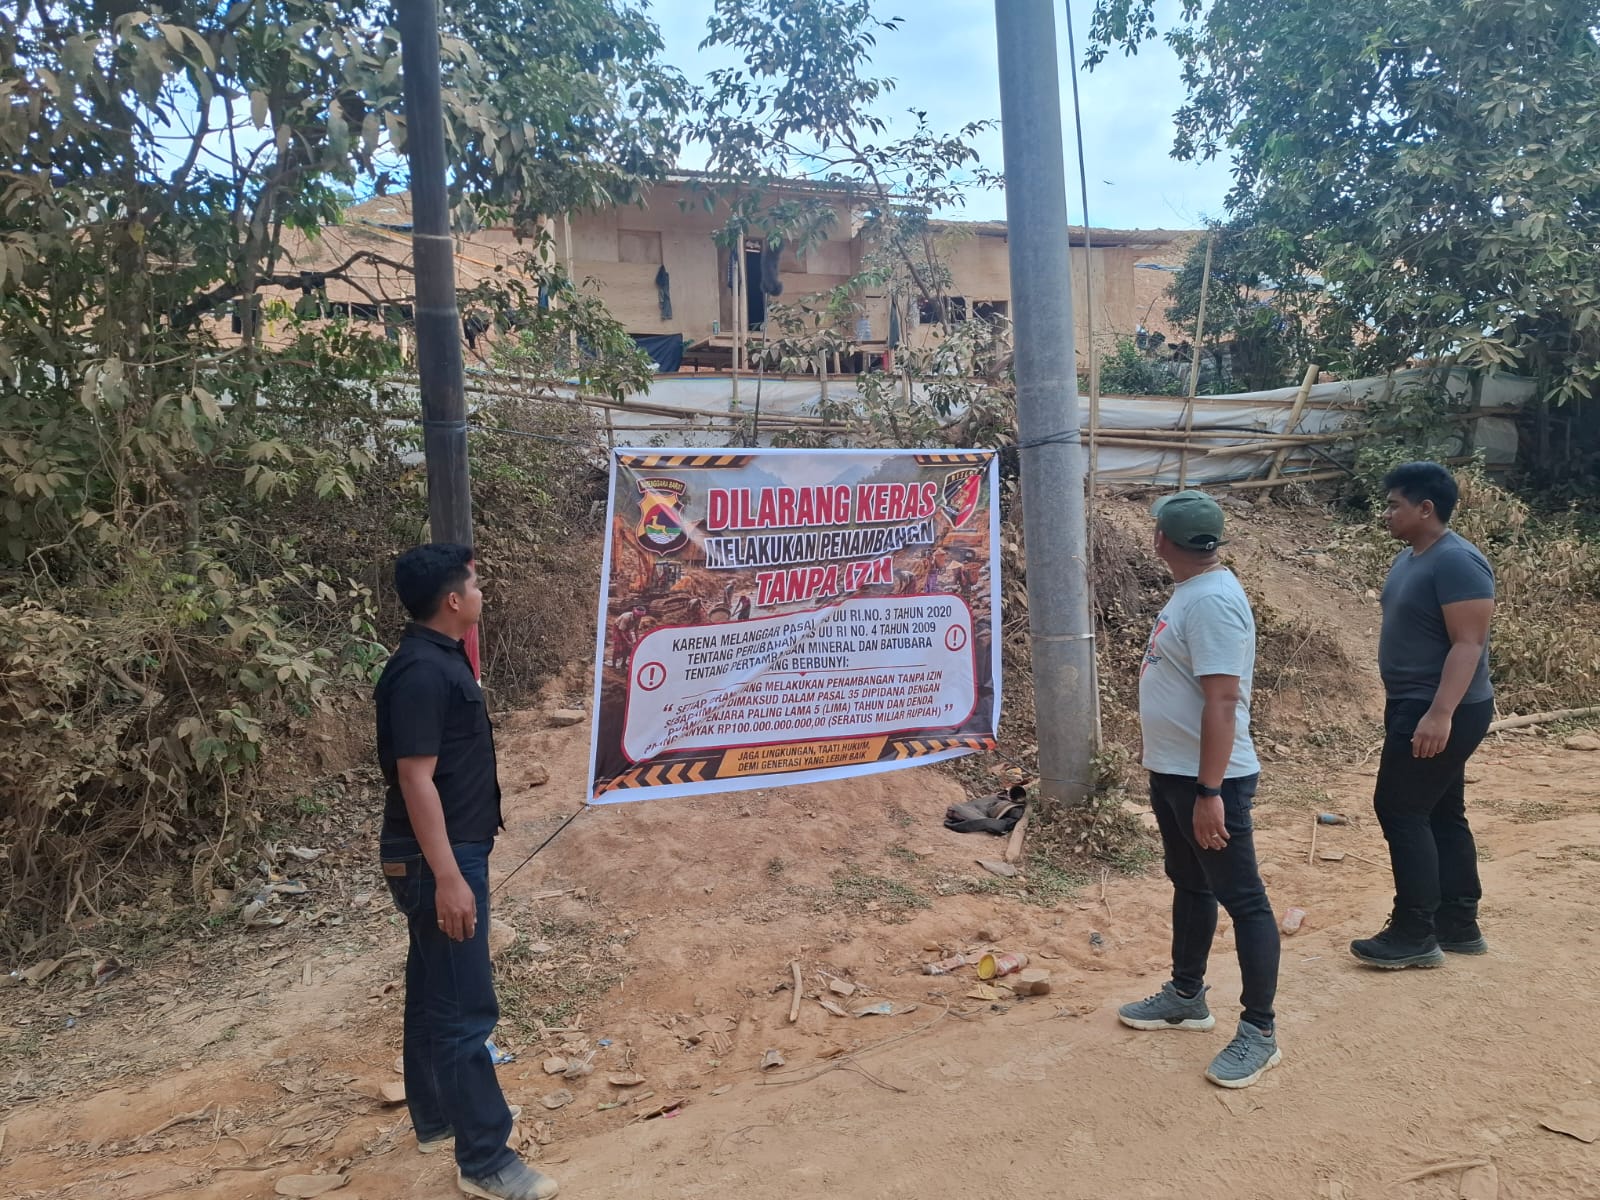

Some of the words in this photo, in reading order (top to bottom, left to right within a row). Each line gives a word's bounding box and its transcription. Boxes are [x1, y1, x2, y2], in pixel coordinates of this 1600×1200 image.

[707, 484, 852, 531] DILARANG
[855, 481, 938, 525] KERAS
[705, 532, 818, 569] MELAKUKAN
[756, 563, 840, 606] TANPA
[672, 635, 718, 652] KARENA
[720, 626, 780, 647] MELANGGAR
[832, 609, 847, 623] UU
[884, 609, 891, 620] 3
[893, 606, 924, 620] TAHUN
[926, 605, 952, 618] 2020
[687, 648, 733, 665] TENTANG
[735, 634, 797, 659] PERUBAHAN
[818, 625, 833, 638] UU
[836, 625, 847, 638] RI
[850, 625, 869, 637] NO.
[871, 624, 877, 636] 4
[880, 622, 909, 636] TAHUN
[911, 621, 936, 634] 2009
[685, 664, 729, 681] TENTANG
[808, 640, 856, 654] MINERAL
[858, 639, 878, 652] DAN
[880, 637, 933, 650] BATUBARA
[767, 659, 789, 672] ANG
[792, 656, 850, 670] BERBUNYI:
[741, 681, 762, 693] ANG
[765, 679, 825, 692] MELAKUKAN
[826, 674, 895, 689] PENAMBANGAN
[898, 672, 926, 684] TANPA
[926, 670, 943, 681] IZIN
[726, 694, 778, 708] DIMAKSUD
[781, 693, 815, 704] DALAM
[817, 690, 846, 701] PASAL
[847, 689, 859, 700] 35
[861, 686, 905, 699] DIPIDANA
[907, 683, 940, 695] DENGAN
[747, 706, 782, 719] PALING
[784, 705, 811, 717] LAMA
[813, 704, 820, 715] 5
[822, 702, 850, 716] (LIMA)
[854, 700, 884, 712] TAHUN
[886, 698, 904, 710] DAN
[906, 695, 933, 707] DENDA
[828, 713, 873, 728] (SERATUS
[875, 710, 904, 723] MILIAR
[906, 706, 942, 719] RUPIAH)
[738, 751, 760, 761] JAGA
[761, 747, 816, 760] LINGKUNGAN,
[818, 744, 840, 754] TAATI
[842, 741, 871, 752] HUKUM,
[738, 760, 759, 772] DEMI
[761, 757, 802, 770] GENERASI
[804, 755, 824, 766] YANG
[825, 752, 848, 763] LEBIH
[849, 751, 867, 761] BAIK
